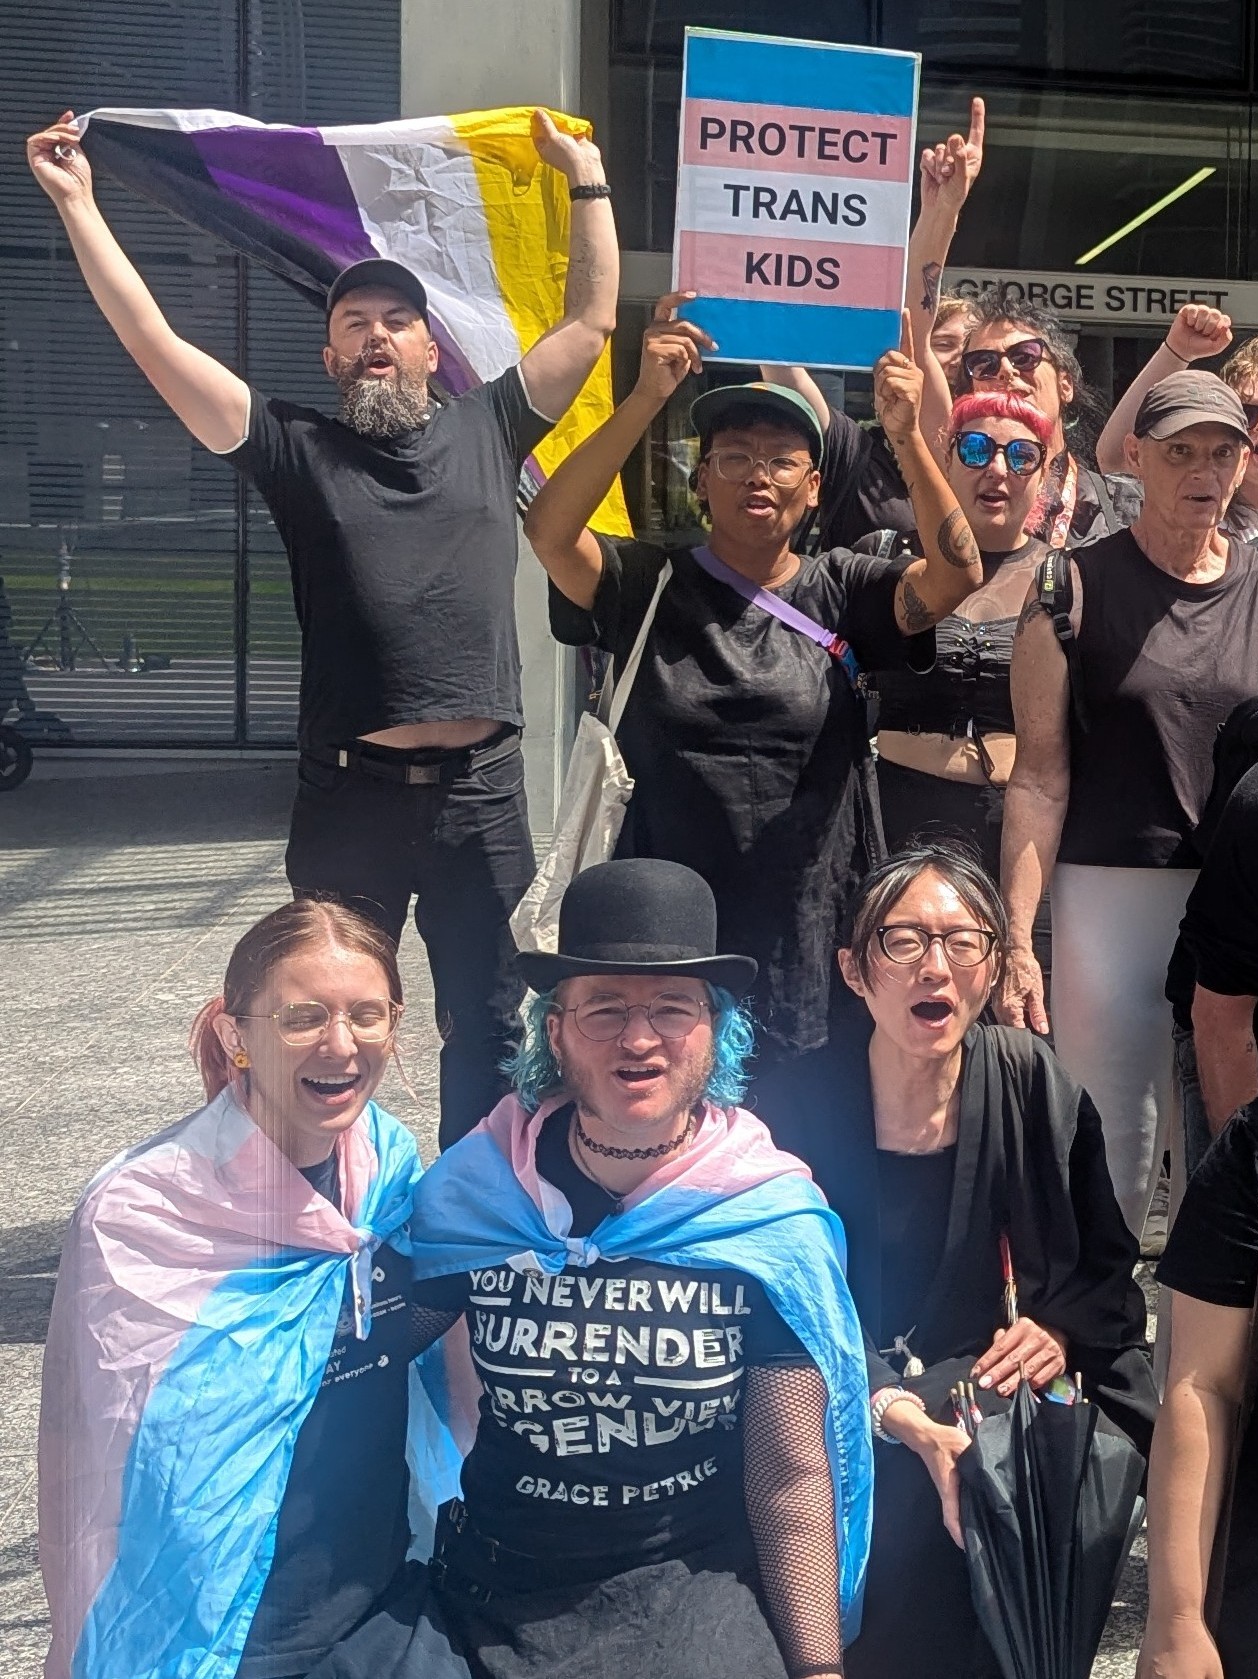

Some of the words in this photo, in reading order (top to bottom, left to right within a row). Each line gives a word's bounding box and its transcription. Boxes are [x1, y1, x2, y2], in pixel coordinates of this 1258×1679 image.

[699, 116, 897, 165] PROTECT
[723, 184, 867, 227] TRANS
[745, 251, 840, 290] KIDS
[1105, 286, 1229, 314] STREET
[469, 1270, 515, 1293] YOU
[522, 1275, 654, 1312] NEVER
[658, 1280, 751, 1316] WILL
[473, 1310, 744, 1368] SURRENDER
[325, 1360, 341, 1375] AY
[568, 1367, 599, 1384] TO
[605, 1370, 621, 1386] A
[484, 1381, 632, 1414] RROW
[516, 1475, 609, 1506] GRACE
[622, 1457, 719, 1505] PETRIE
